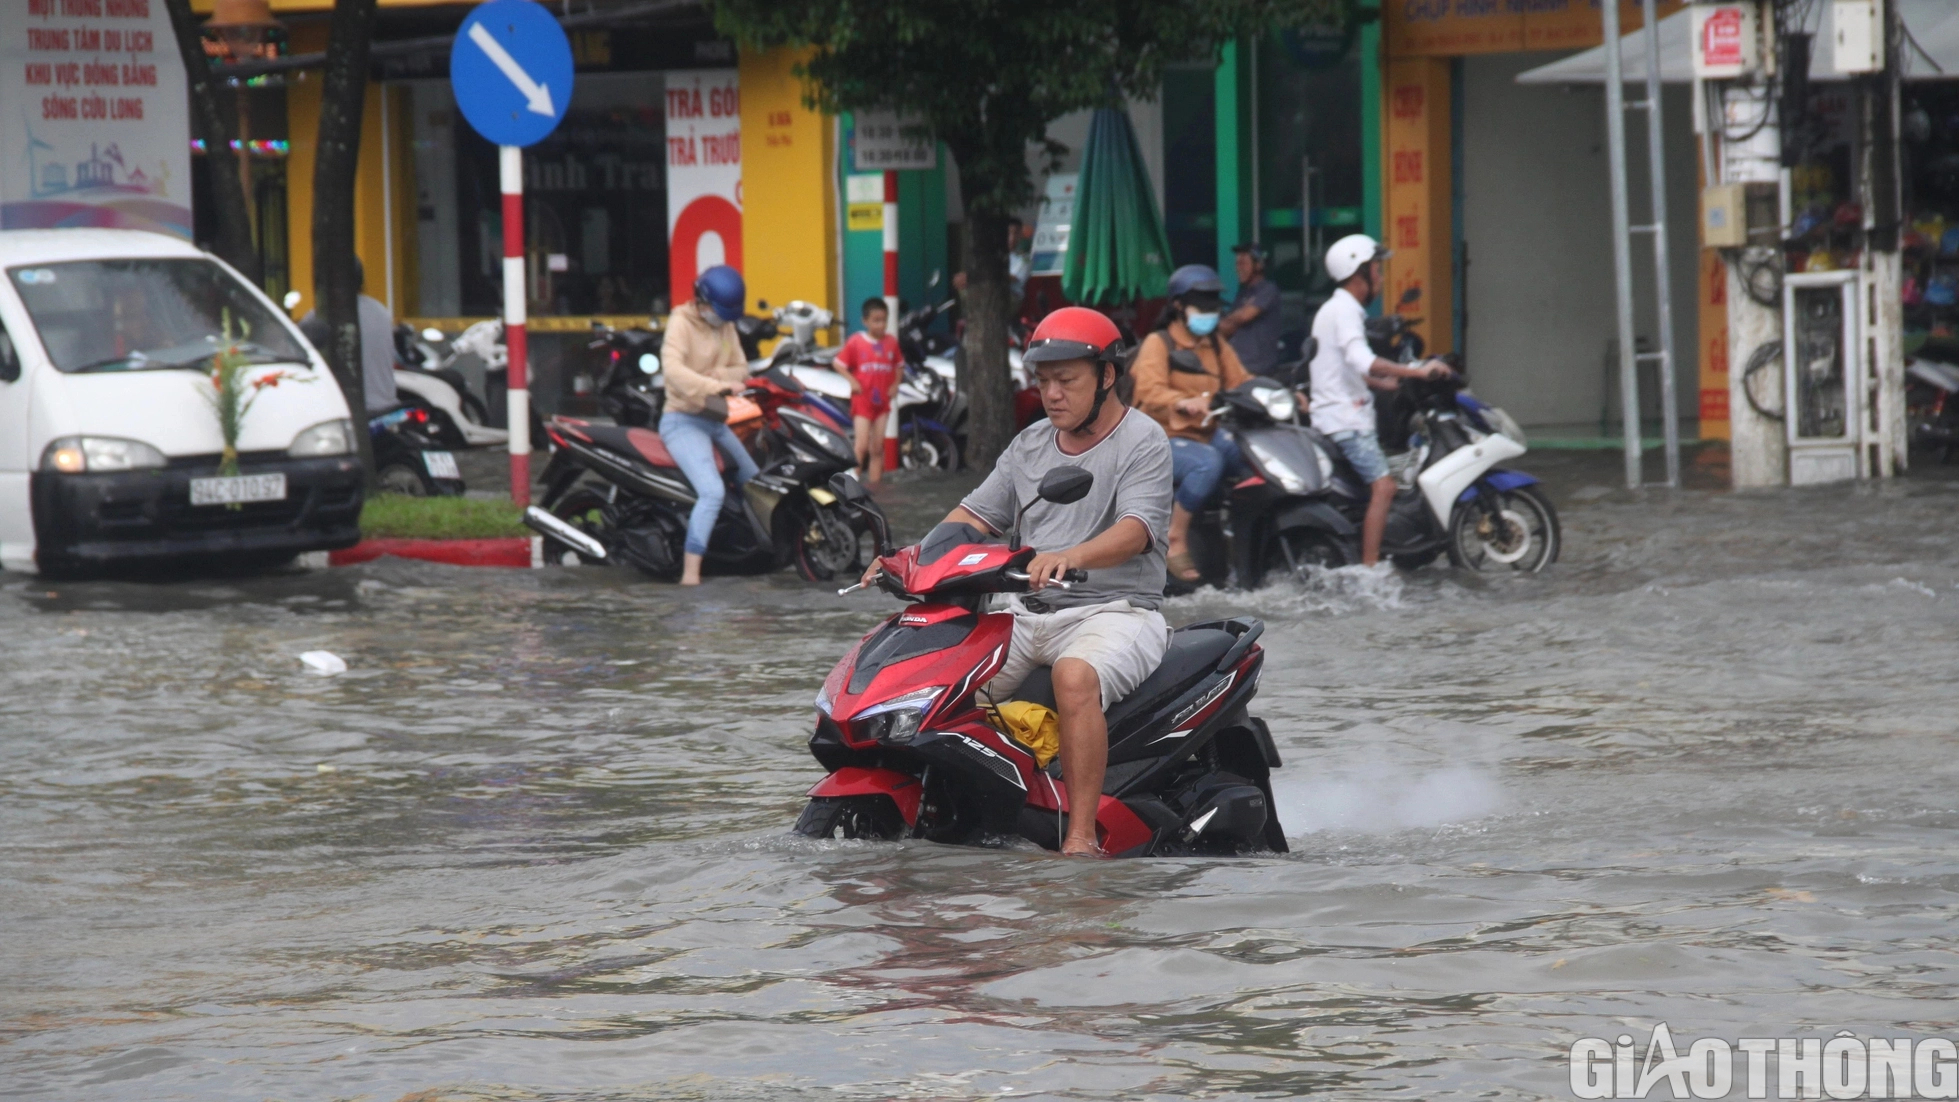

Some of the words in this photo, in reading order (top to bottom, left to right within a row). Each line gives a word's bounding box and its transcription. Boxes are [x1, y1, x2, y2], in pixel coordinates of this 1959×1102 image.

[27, 28, 69, 51] TRUNG
[72, 23, 100, 51] TÂM
[104, 29, 121, 52] DU
[124, 30, 153, 58] LỊCH
[25, 62, 51, 86] KHU
[54, 62, 80, 91] VỰC
[42, 91, 79, 119] SÔNG
[81, 89, 108, 120] CỬU
[110, 97, 144, 120] LONG
[666, 77, 703, 118] TRẢ
[668, 124, 697, 166] TRẢ
[962, 736, 997, 757] 125
